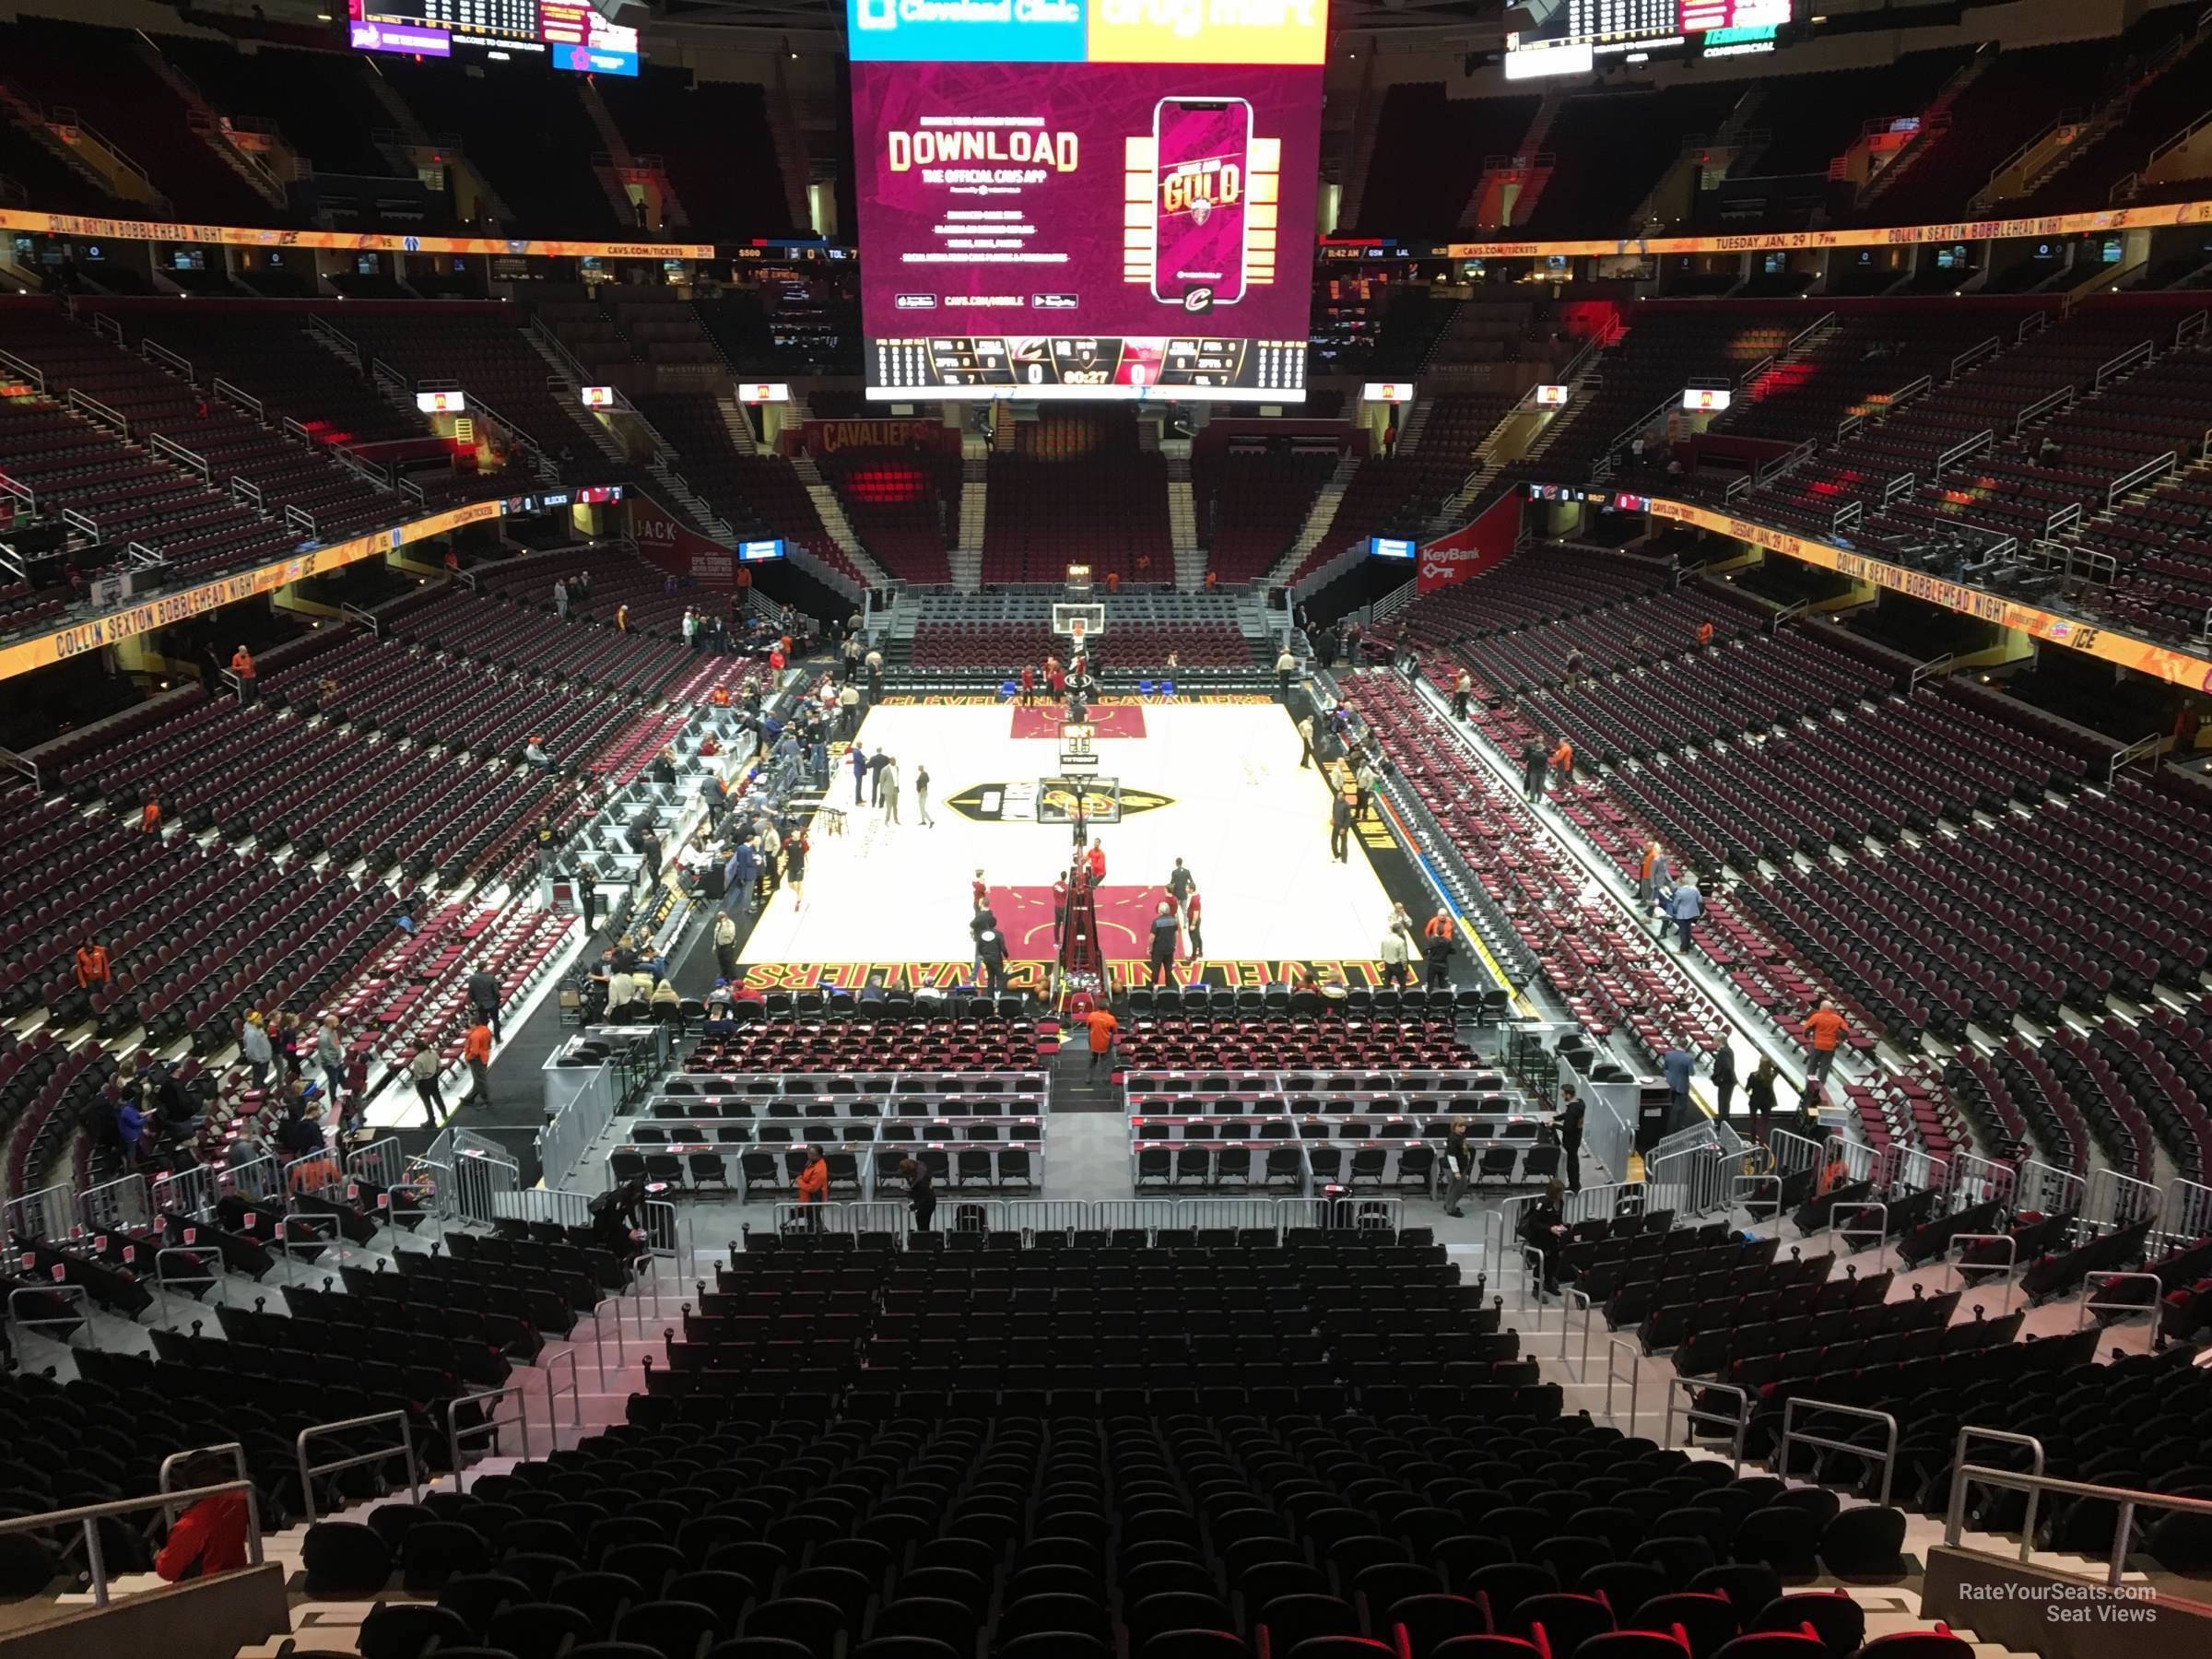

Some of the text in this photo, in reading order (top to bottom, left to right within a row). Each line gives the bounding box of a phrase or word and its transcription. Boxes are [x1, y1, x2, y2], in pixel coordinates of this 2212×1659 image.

[888, 131, 1078, 171] DOWNLOAD
[922, 170, 944, 183] THE
[1164, 164, 1240, 213] GOLD
[118, 221, 187, 241] BOBBLEHEAD
[193, 227, 222, 242] NIGHT
[1927, 224, 1966, 241] SEXTON
[1971, 220, 2034, 240] BOBBLEHEAD
[2039, 218, 2063, 235] NIGHT
[1765, 234, 1787, 248] JAN.
[1792, 233, 1806, 246] 29
[607, 245, 684, 256] CAVS.COM/TICKETS
[850, 249, 858, 259] 7
[1463, 245, 1538, 256] CAVS.COM/TICKETS
[1028, 363, 1043, 384] 0
[1131, 364, 1146, 384] 0
[524, 499, 532, 510] 0
[544, 495, 567, 505] BLOCKS
[582, 491, 590, 503] 0
[1423, 547, 1480, 561] KeyBank
[1869, 560, 1903, 589] SEXTON
[1906, 571, 1971, 613] BOBBLEHEAD
[1974, 592, 2009, 624] NIGHT
[108, 606, 154, 640] SEXTON
[159, 585, 225, 624] BOBBLEHEAD
[229, 573, 257, 598] NIGHT
[882, 695, 1053, 707] CLEVELAN
[742, 963, 1045, 989] CVALIERS
